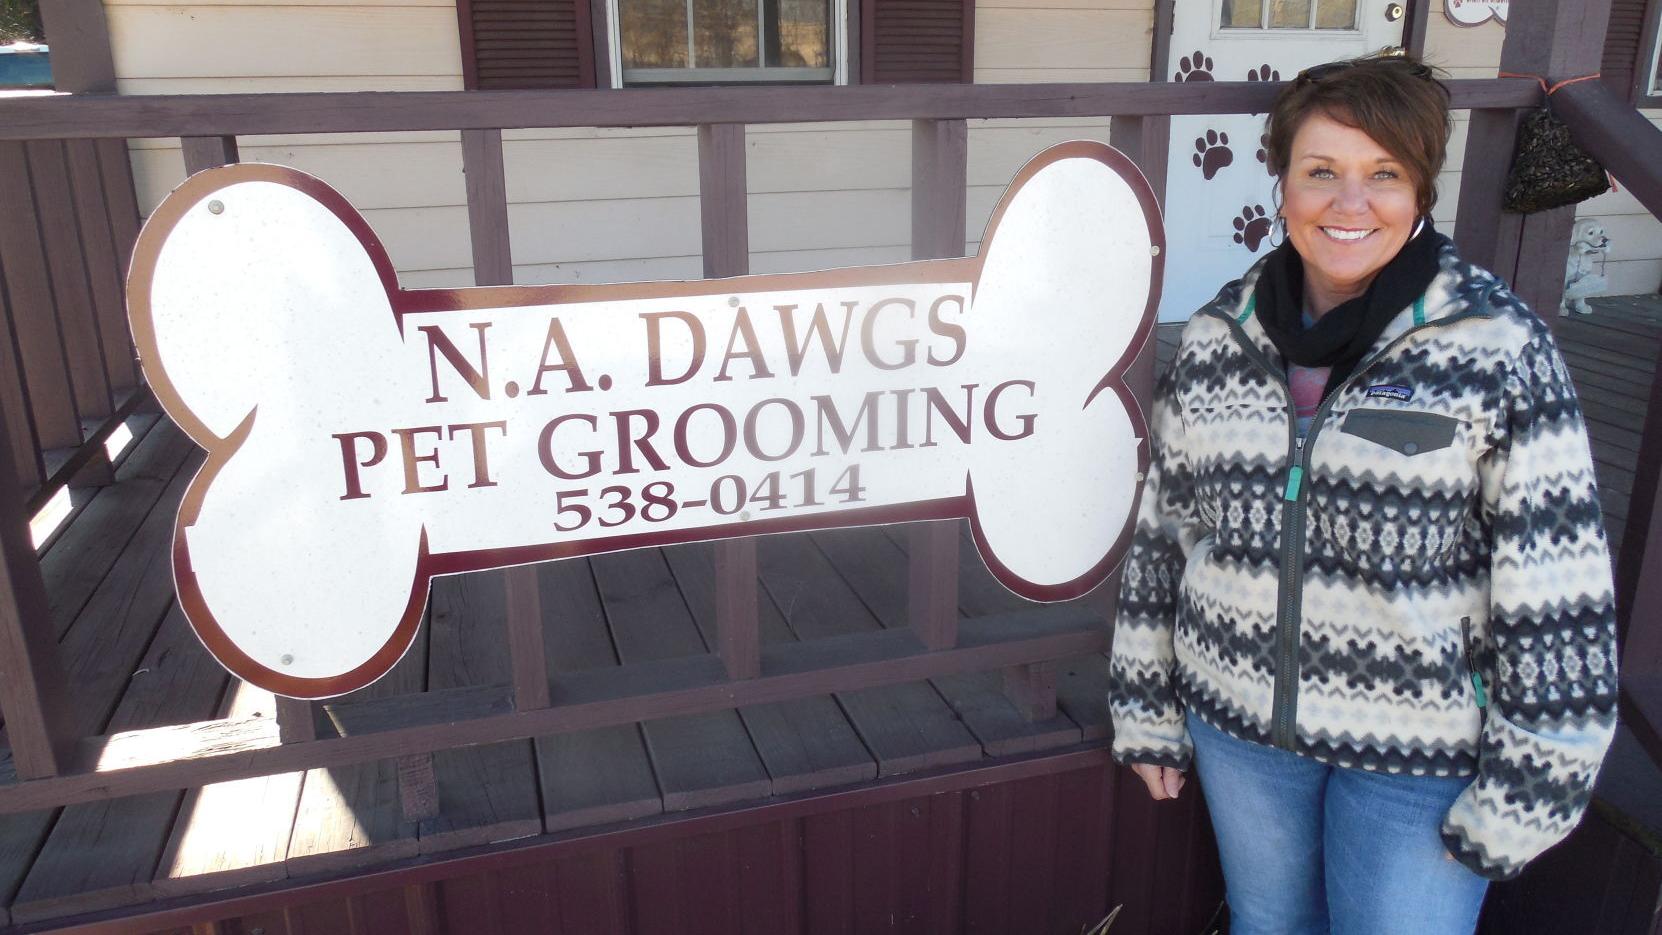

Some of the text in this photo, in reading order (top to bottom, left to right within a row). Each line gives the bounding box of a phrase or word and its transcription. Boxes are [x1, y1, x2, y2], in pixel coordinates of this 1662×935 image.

[418, 294, 967, 403] N.A. DAWGS
[1370, 390, 1406, 399] patagonia
[332, 379, 1038, 501] PET GROOMING
[553, 463, 867, 532] 538-0414
